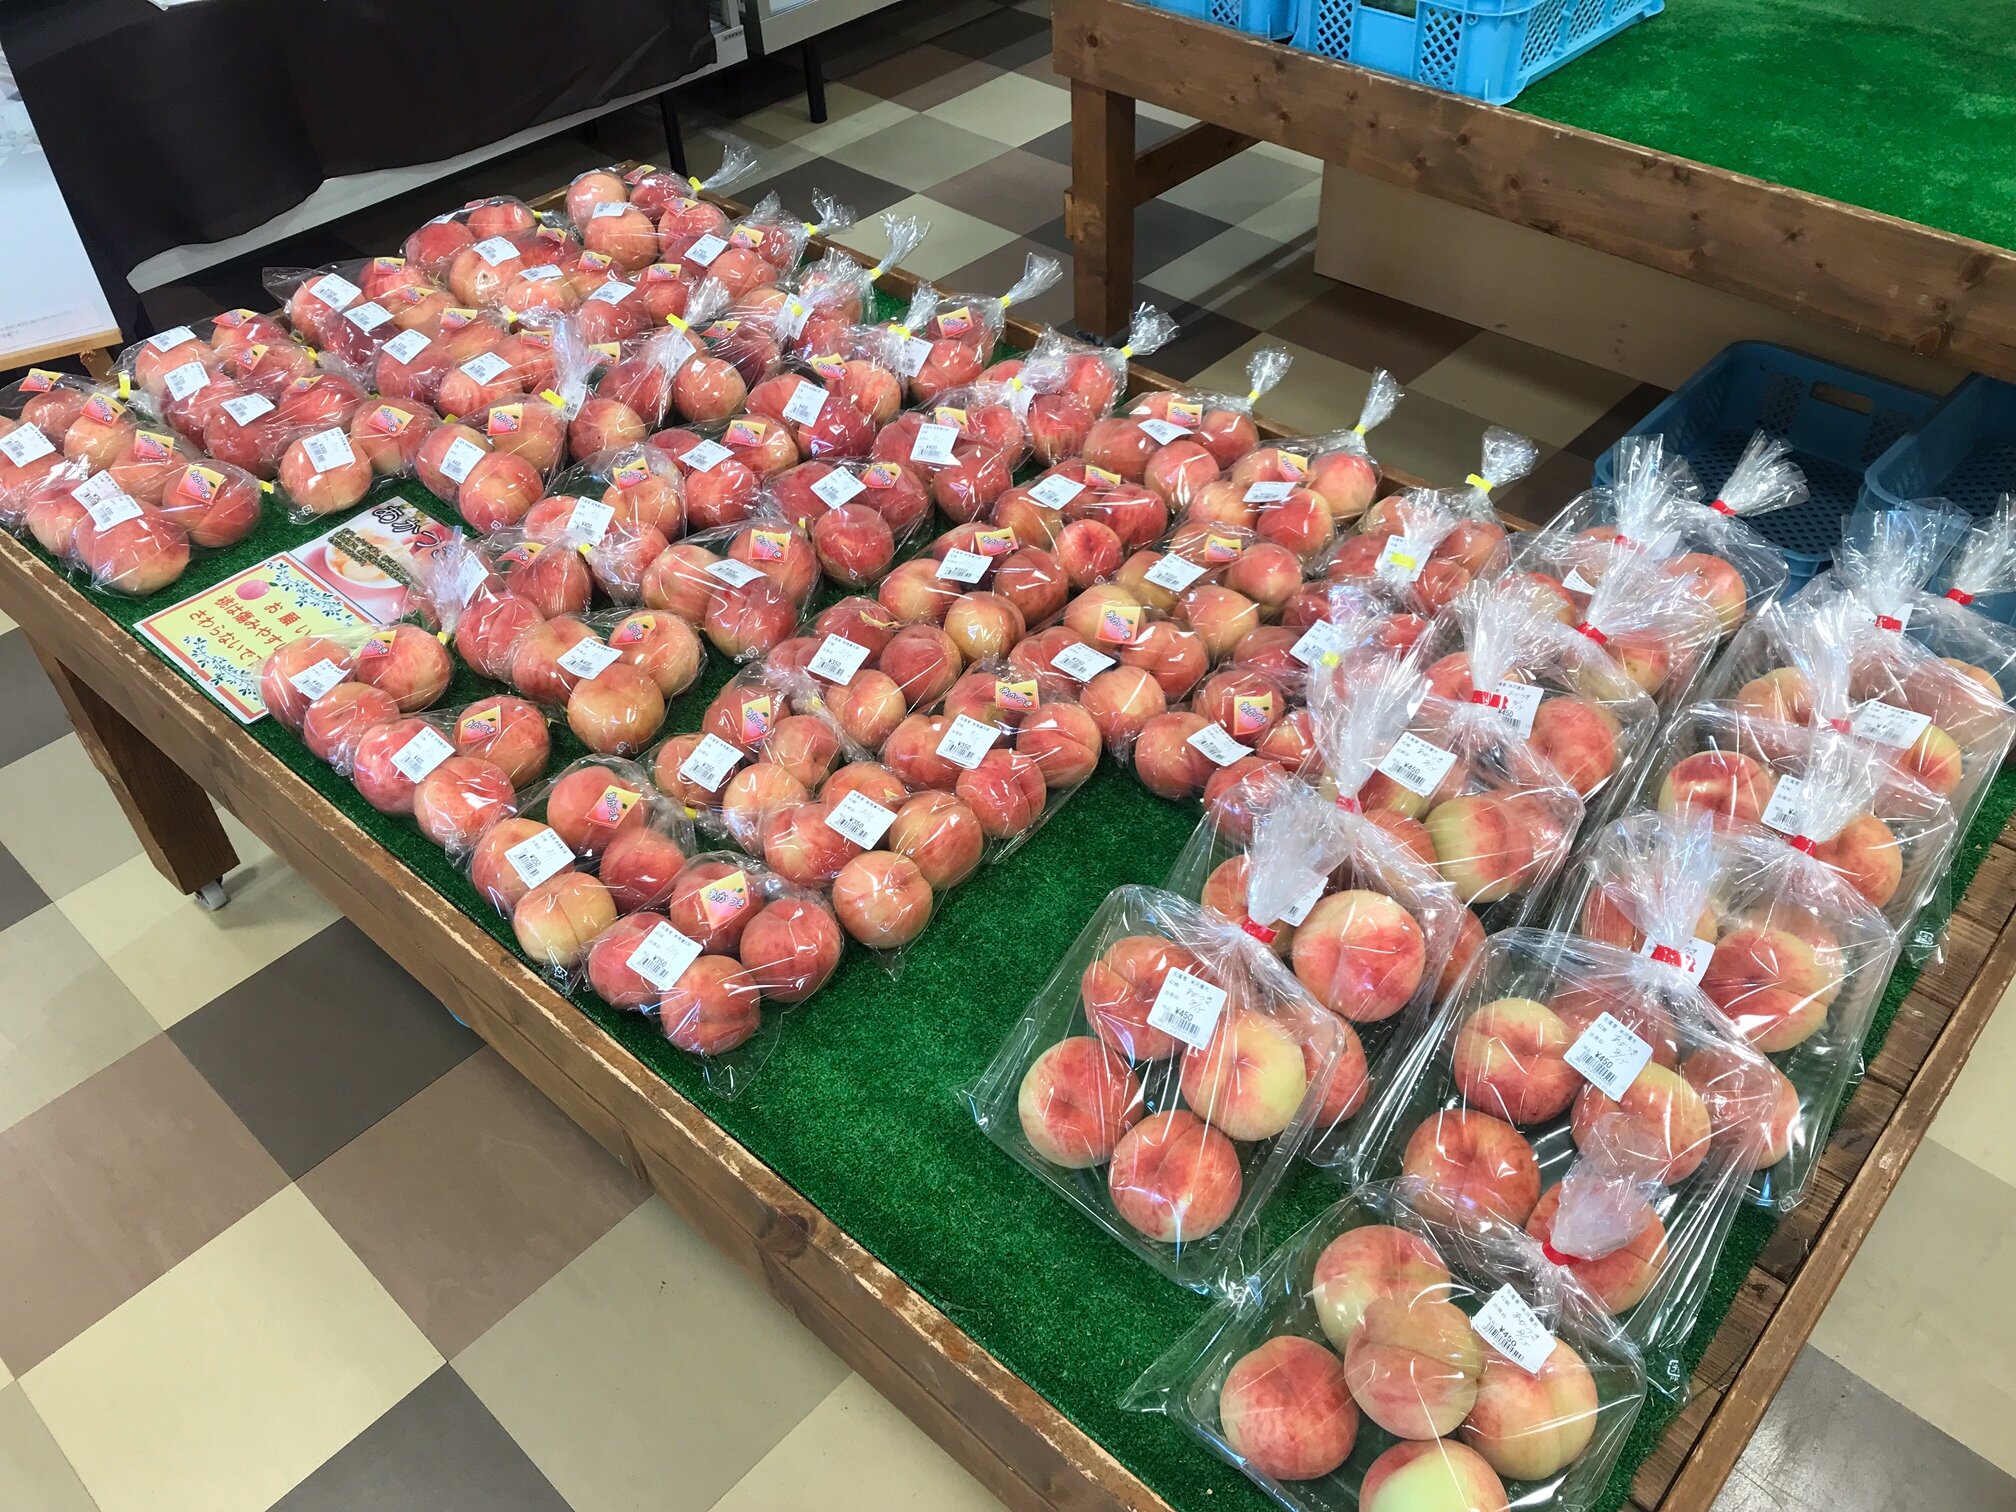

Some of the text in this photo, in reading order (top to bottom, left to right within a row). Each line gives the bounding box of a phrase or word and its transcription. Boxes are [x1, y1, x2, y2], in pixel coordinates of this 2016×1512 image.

[493, 411, 517, 431] あかつき
[755, 535, 781, 558] あかつき
[264, 601, 311, 636] お願い
[1106, 610, 1132, 640] あかつき
[828, 658, 842, 667] ¥350
[1000, 686, 1033, 707] あかつき
[745, 708, 767, 734] あかつき
[1239, 702, 1267, 725] あかつき
[1498, 708, 1514, 718] ¥450
[957, 741, 972, 750] ¥350
[702, 762, 713, 772] ¥350
[1403, 763, 1420, 774] ¥450
[605, 791, 619, 821] あかつき
[849, 818, 864, 828] ¥350
[529, 854, 541, 867] ¥350
[707, 890, 746, 908] あかつき
[653, 955, 667, 967] ¥350
[1175, 1007, 1194, 1021] ¥450
[1595, 1051, 1613, 1068] ¥450
[1498, 1325, 1517, 1346] ¥450
